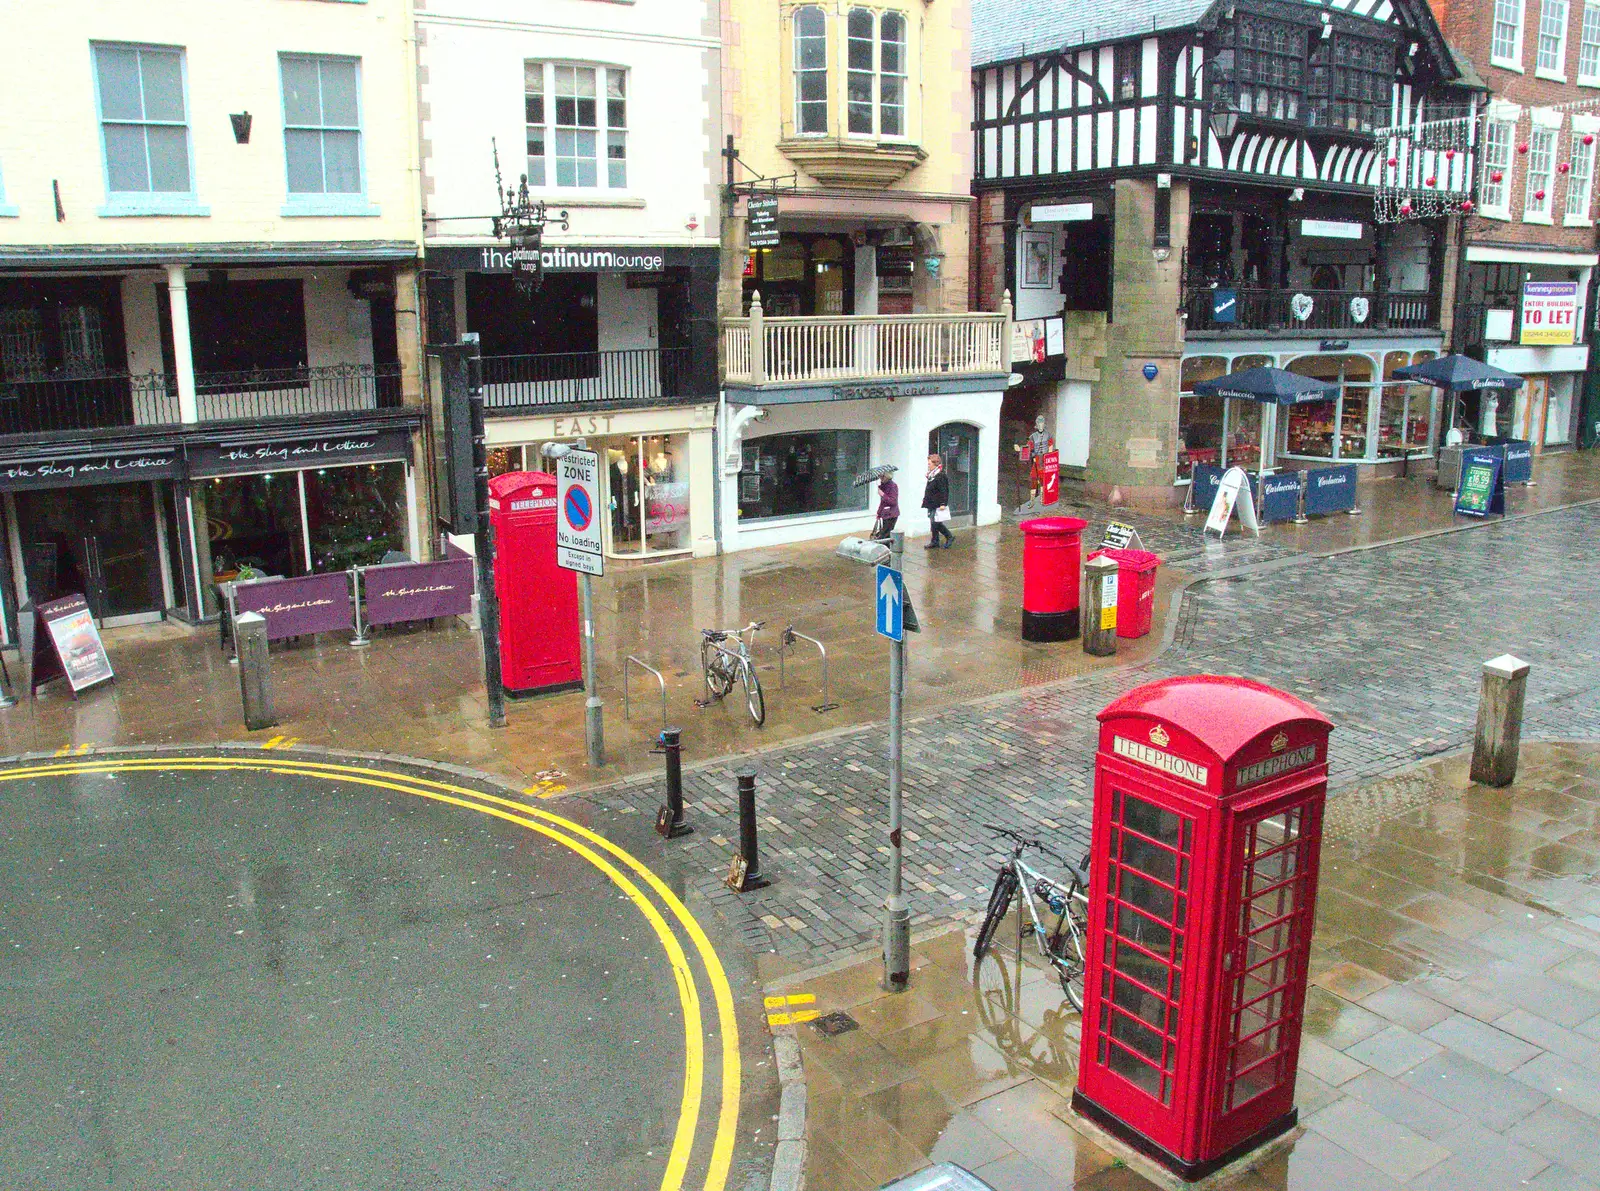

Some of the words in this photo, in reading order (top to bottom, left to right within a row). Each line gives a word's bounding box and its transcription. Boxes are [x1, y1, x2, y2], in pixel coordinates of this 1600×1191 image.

[512, 247, 540, 263] platinum
[541, 248, 612, 268] atinum
[613, 252, 662, 270] lounge
[521, 261, 537, 273] lounge
[1524, 310, 1542, 325] TO
[1548, 310, 1573, 325] LET
[553, 414, 616, 437] EAST
[255, 444, 289, 460] Slug
[291, 442, 321, 455] and
[38, 460, 75, 478] Slug
[79, 458, 111, 472] and
[564, 466, 592, 482] ZONE
[1317, 475, 1347, 487] Carluccio's
[513, 498, 557, 510] TELEPHON
[558, 532, 570, 544] No
[572, 535, 600, 552] loading
[565, 560, 582, 569] signed
[568, 551, 585, 562] Except
[1118, 737, 1205, 783] TELEPHONE
[1238, 746, 1316, 784] TELEPHONE
